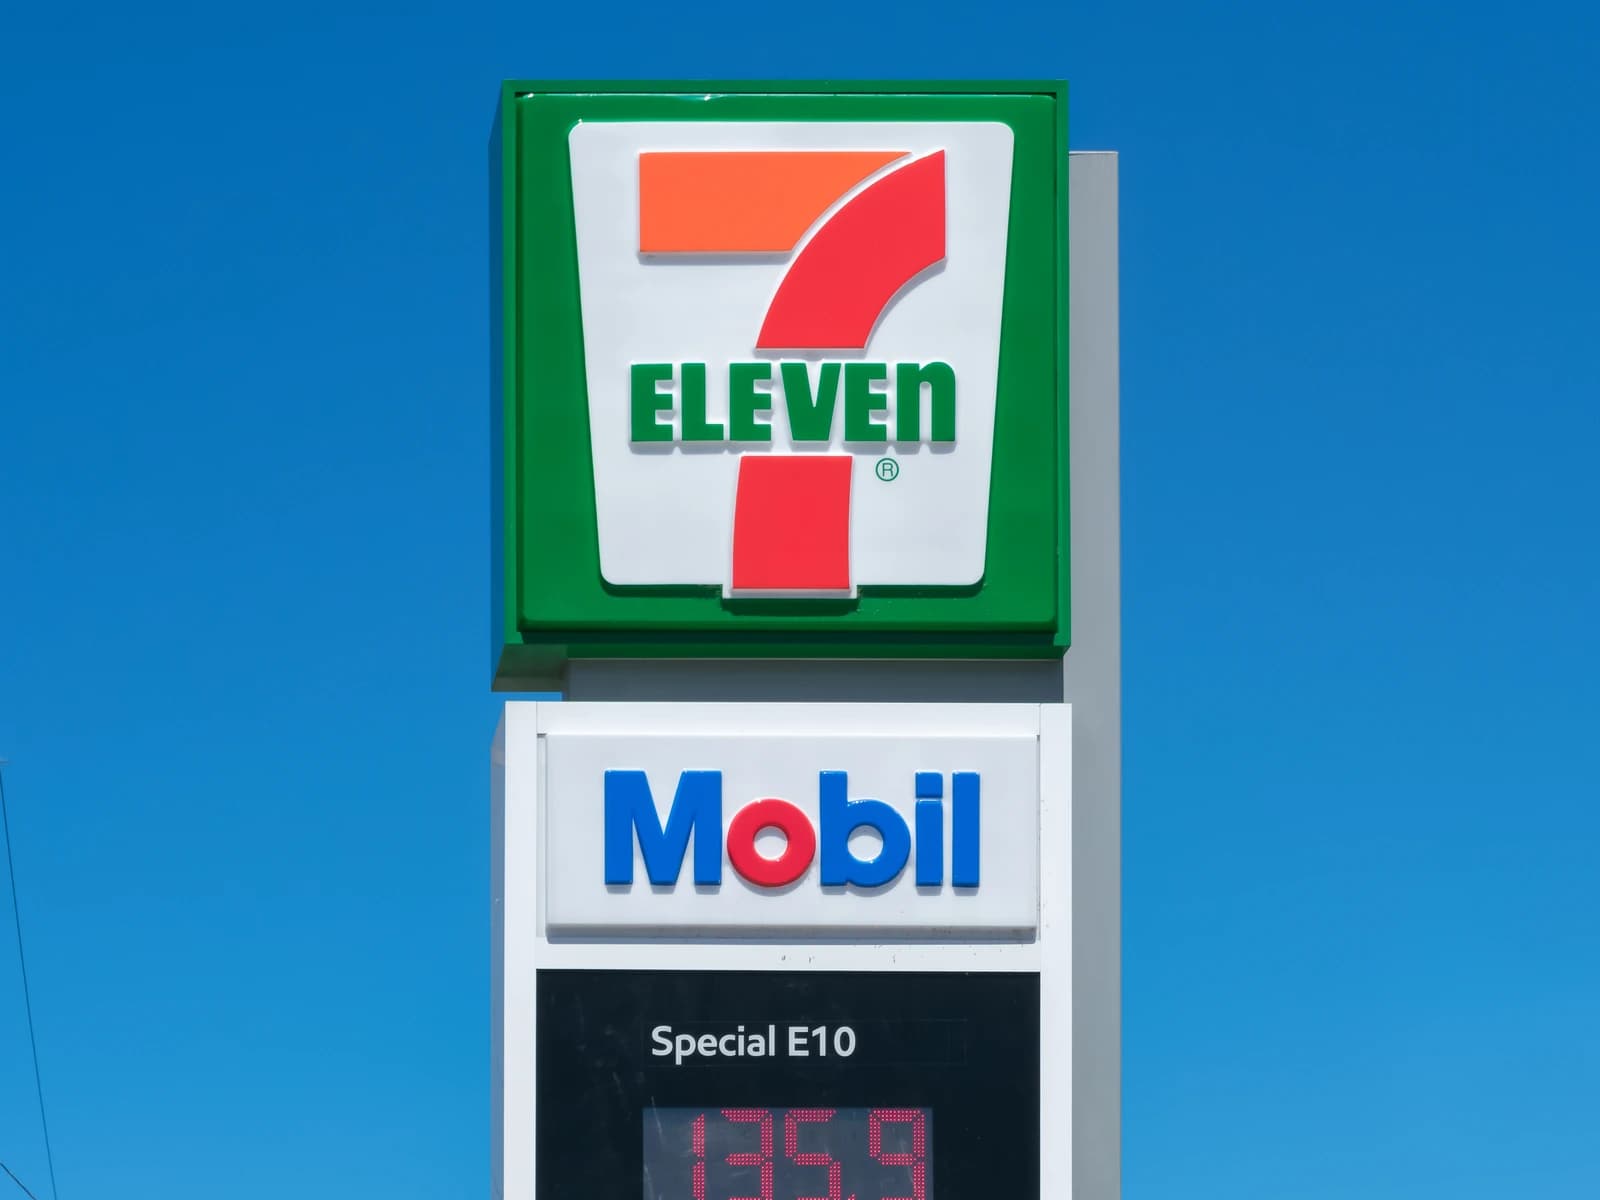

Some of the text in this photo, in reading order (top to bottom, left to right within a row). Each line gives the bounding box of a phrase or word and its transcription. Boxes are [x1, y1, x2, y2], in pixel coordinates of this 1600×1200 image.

[640, 150, 946, 590] 7
[604, 769, 981, 888] Mobil
[651, 1024, 856, 1066] Special E10
